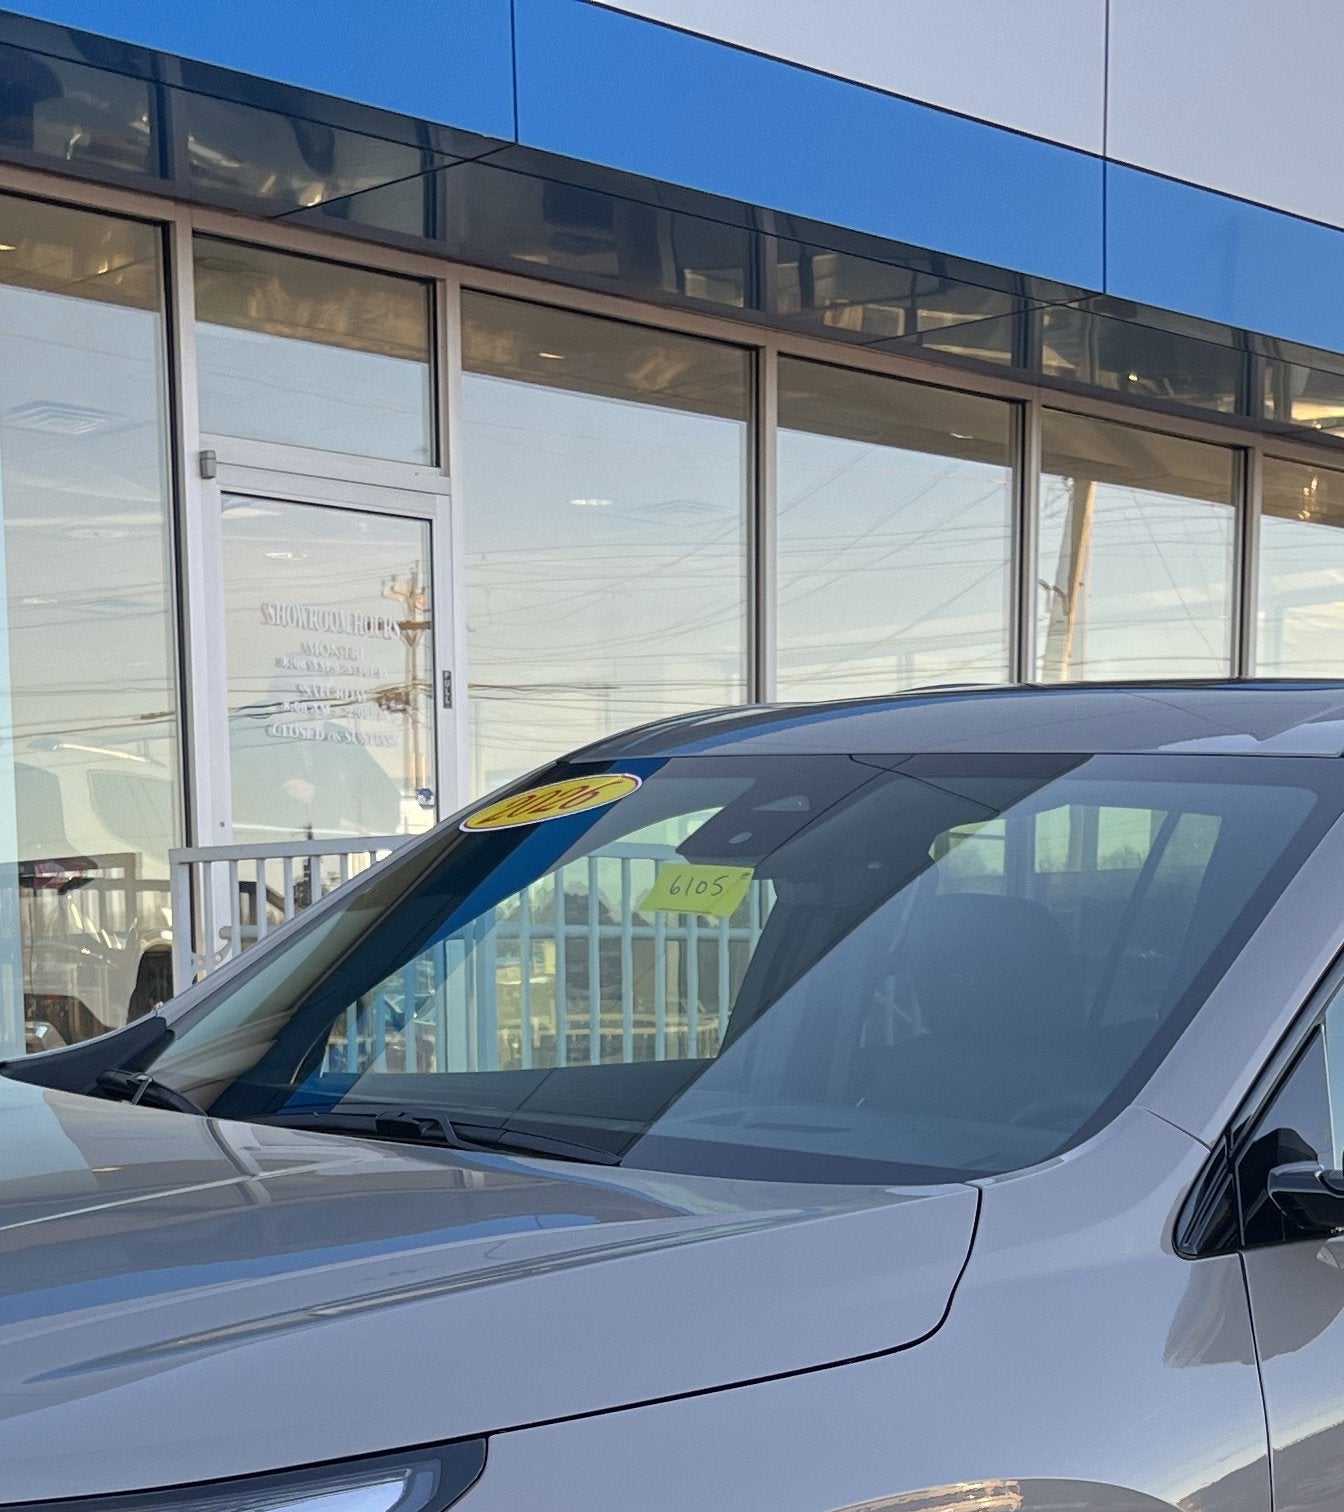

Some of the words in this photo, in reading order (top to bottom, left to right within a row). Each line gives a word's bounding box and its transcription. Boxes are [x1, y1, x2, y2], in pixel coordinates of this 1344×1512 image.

[353, 611, 401, 639] HOURS
[270, 722, 325, 741] CLOSED
[475, 780, 624, 825] 2026
[669, 875, 729, 897] 6105
